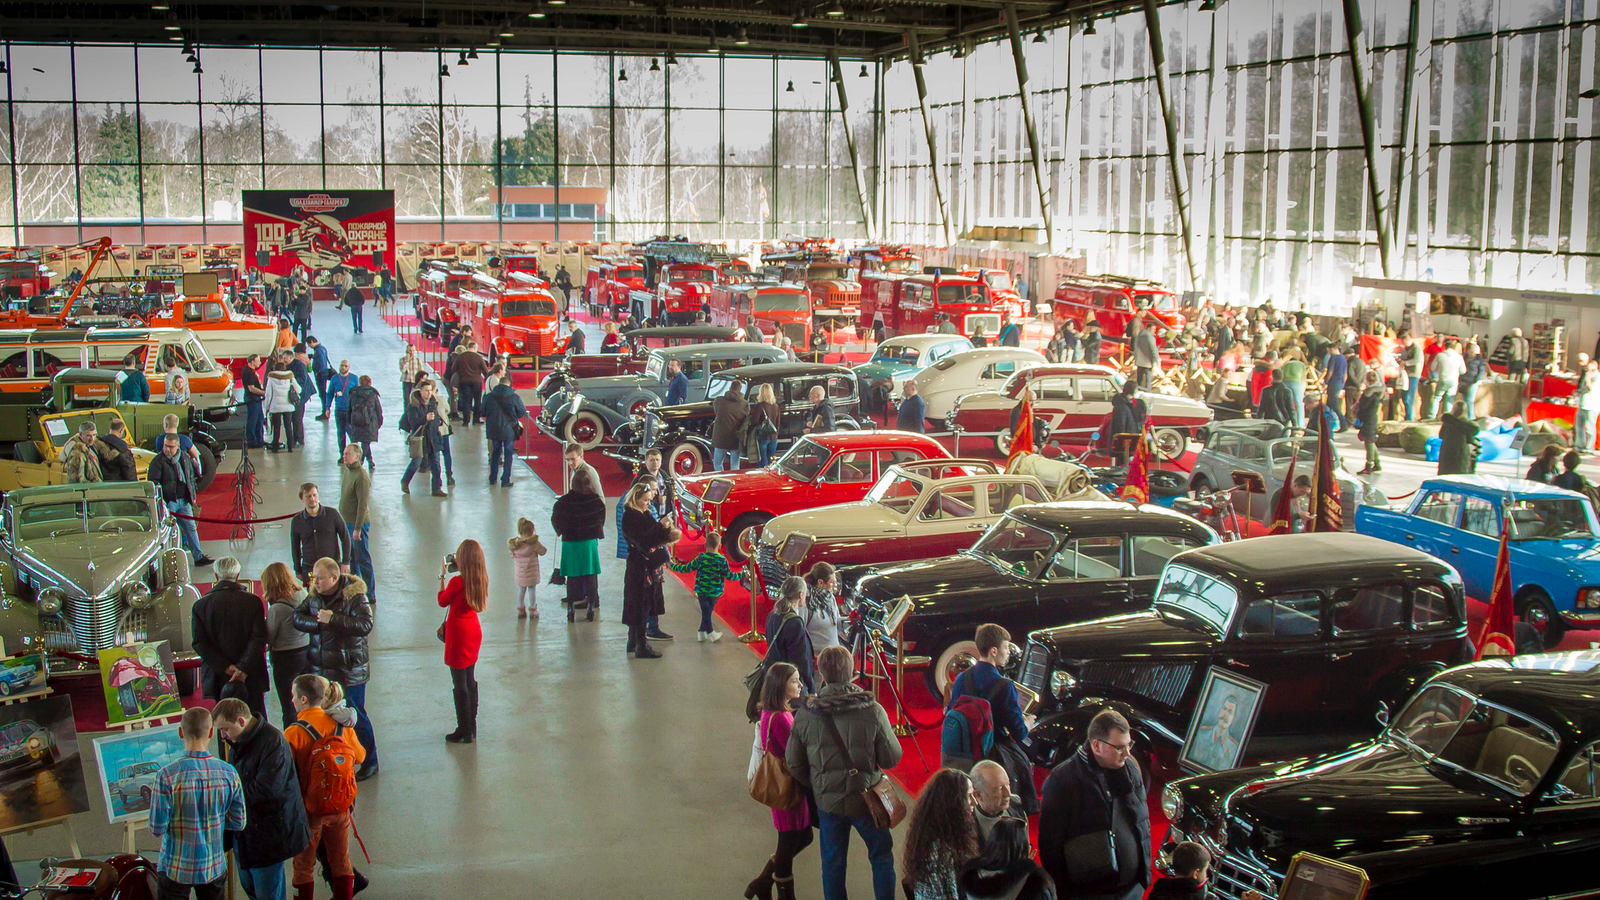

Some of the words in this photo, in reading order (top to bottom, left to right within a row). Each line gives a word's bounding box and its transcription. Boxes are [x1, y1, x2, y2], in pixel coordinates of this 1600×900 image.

[254, 223, 285, 241] 100
[348, 221, 387, 230] ПОЖАРНОЙ
[348, 230, 387, 240] ОХРАНЕ
[255, 241, 284, 256] ЛЕТ
[350, 240, 387, 255] СССР
